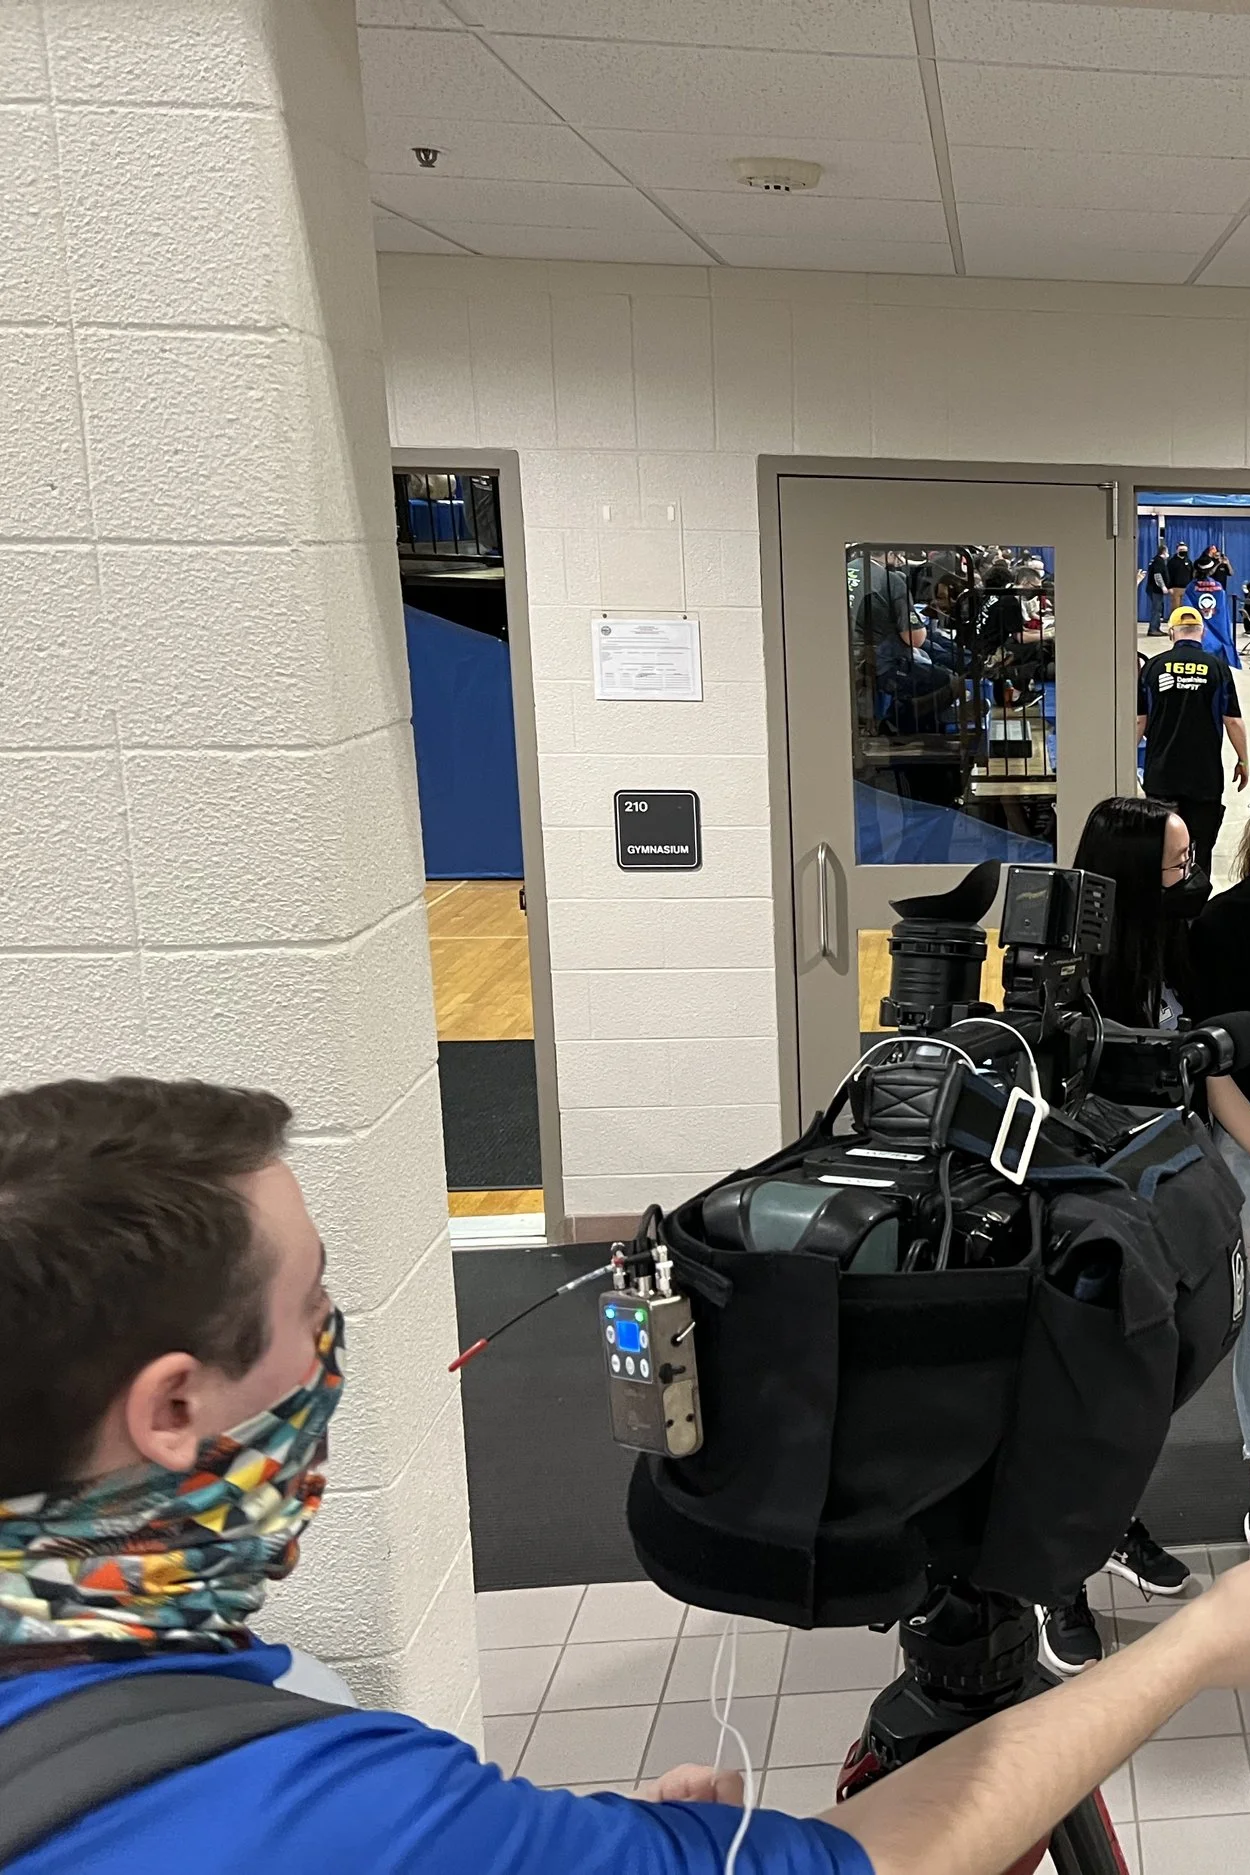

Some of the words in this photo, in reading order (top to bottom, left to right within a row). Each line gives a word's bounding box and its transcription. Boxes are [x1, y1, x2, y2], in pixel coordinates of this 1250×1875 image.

[1165, 662, 1208, 676] 1699
[624, 801, 648, 812] 210
[627, 845, 689, 854] GYMNASIUM
